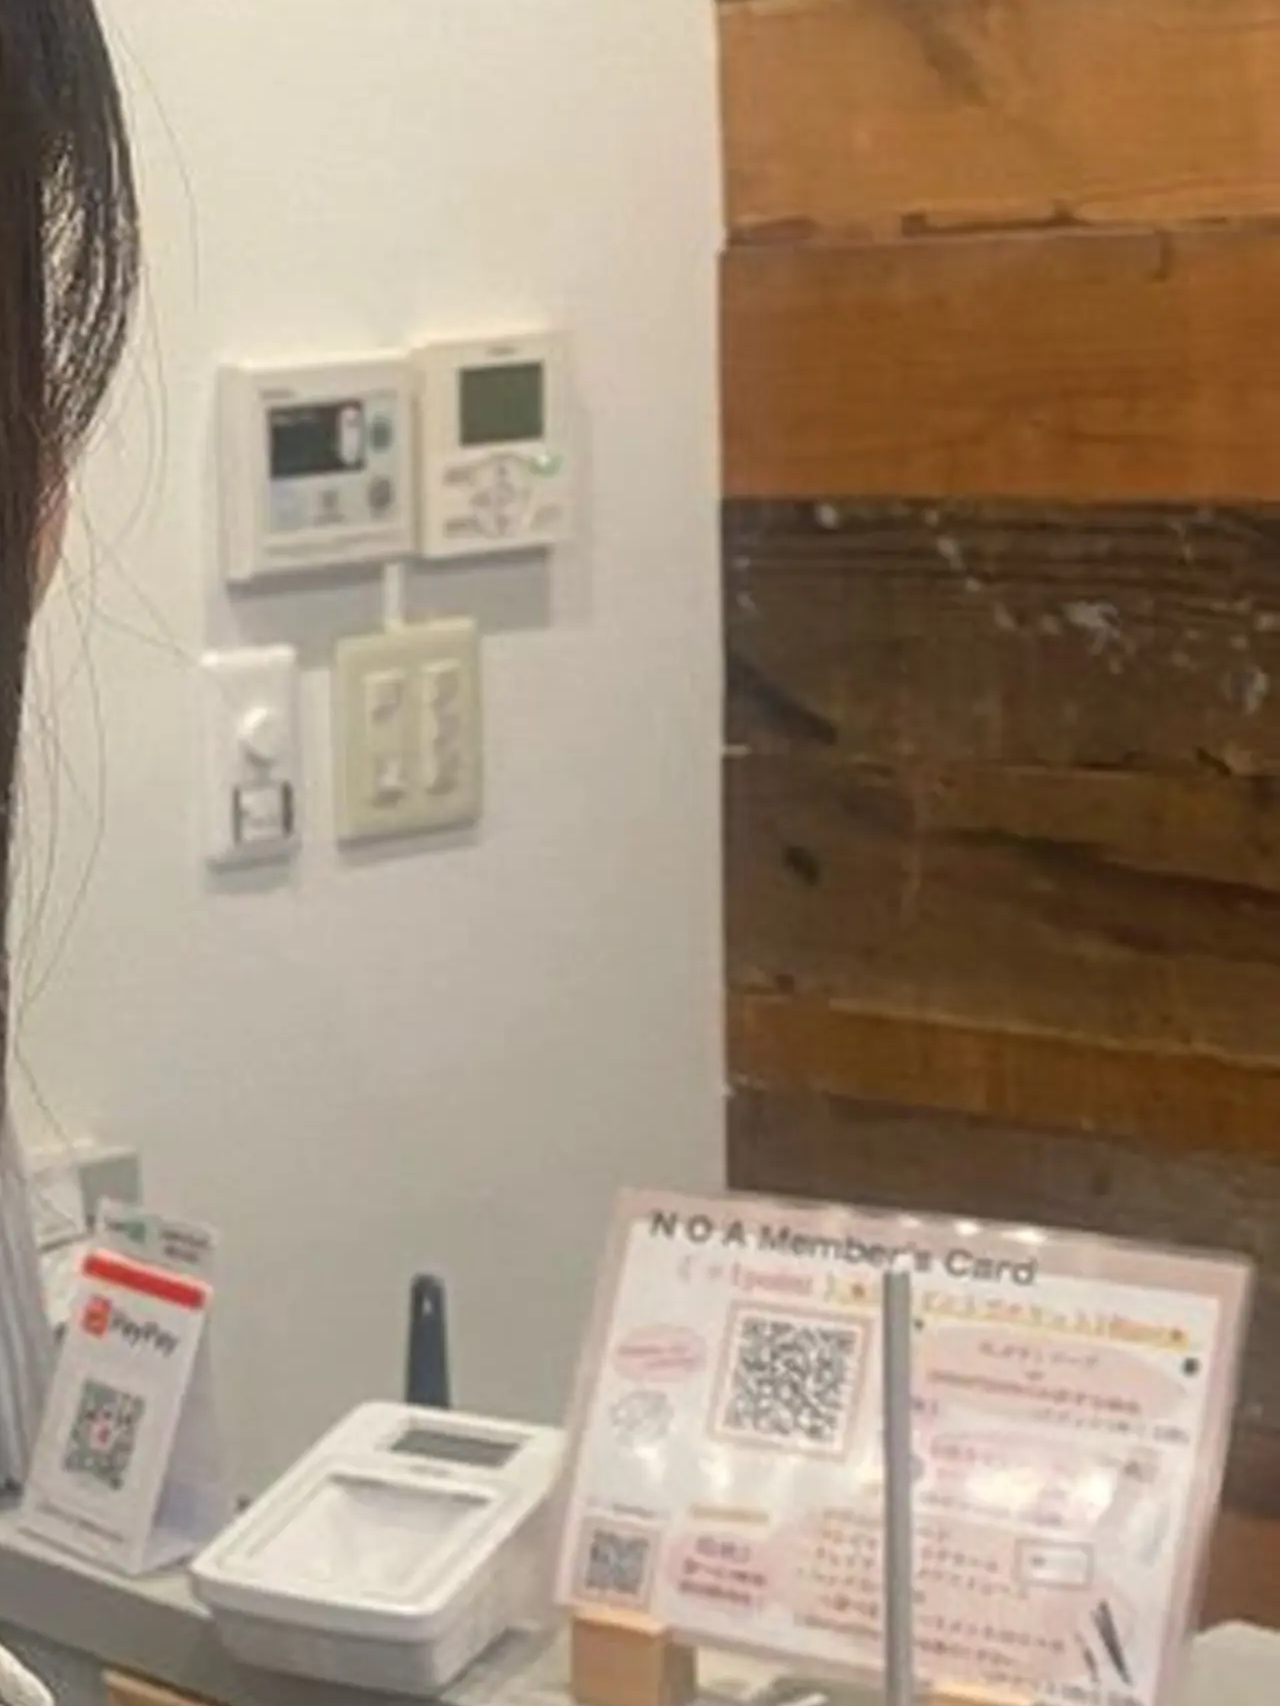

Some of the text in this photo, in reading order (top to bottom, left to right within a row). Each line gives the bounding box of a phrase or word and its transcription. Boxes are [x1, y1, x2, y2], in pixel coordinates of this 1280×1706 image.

[759, 1224, 933, 1274] Member's
[945, 1247, 1039, 1288] Card
[112, 1309, 179, 1360] PayPay
